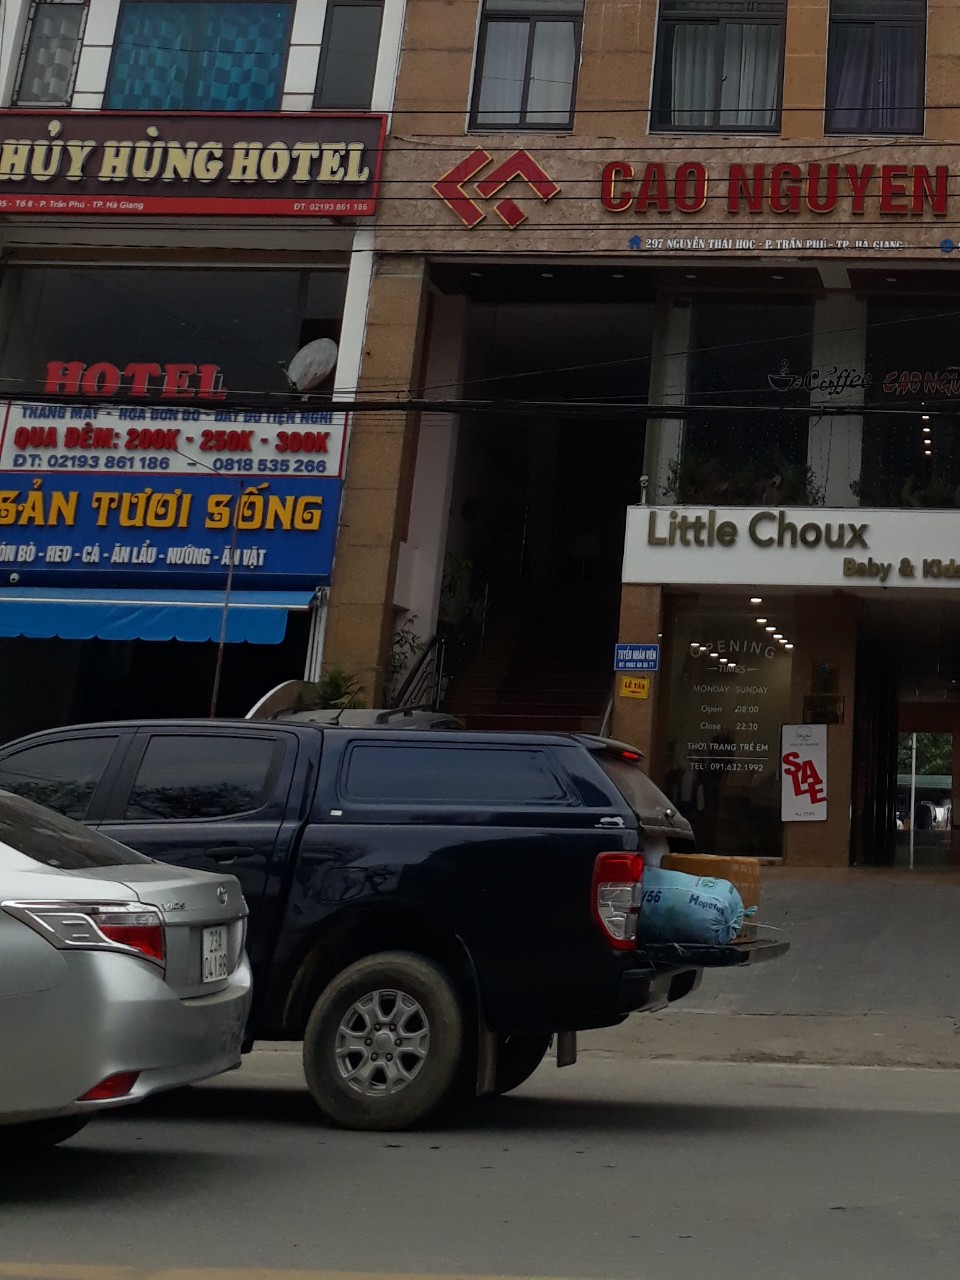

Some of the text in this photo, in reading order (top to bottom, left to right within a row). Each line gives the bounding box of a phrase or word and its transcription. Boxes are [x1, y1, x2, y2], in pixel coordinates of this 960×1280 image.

[98, 125, 224, 184] HÙNG
[228, 141, 370, 185] HOTEL
[601, 161, 709, 215] CAO
[727, 162, 949, 216] NGUYEN
[120, 201, 144, 210] Giang
[336, 203, 350, 211] 861
[353, 203, 368, 211] 186
[645, 238, 663, 249] 297
[708, 236, 732, 249] THÁI
[873, 240, 903, 251] GIANG
[44, 360, 229, 400] HOTEL
[13, 426, 58, 450] QUA
[124, 428, 181, 451] 200K
[199, 429, 254, 453] 250K
[275, 431, 331, 454] 300K
[47, 454, 100, 469] 02193
[104, 455, 135, 469] 861
[140, 456, 170, 470] 186
[213, 457, 253, 471] 0818
[257, 458, 290, 472] 535
[293, 459, 326, 473] 266
[92, 487, 192, 528] TƯƠI
[205, 482, 323, 531] SỐNG
[648, 509, 869, 549] Little Choux
[17, 541, 36, 562] BÒ
[45, 545, 72, 563] HEO
[81, 542, 100, 563] CÁ
[110, 542, 131, 563] ĂN
[166, 544, 212, 565] NƯỚNG
[843, 556, 891, 582] Baby
[899, 557, 915, 577] &
[693, 685, 768, 694] MONDAY SUNDAY
[701, 704, 723, 714] Open
[700, 721, 758, 730] Close 22:30
[709, 742, 737, 751] TRANG
[756, 743, 769, 751] EM
[690, 762, 764, 772] TEL: 091.632.1992
